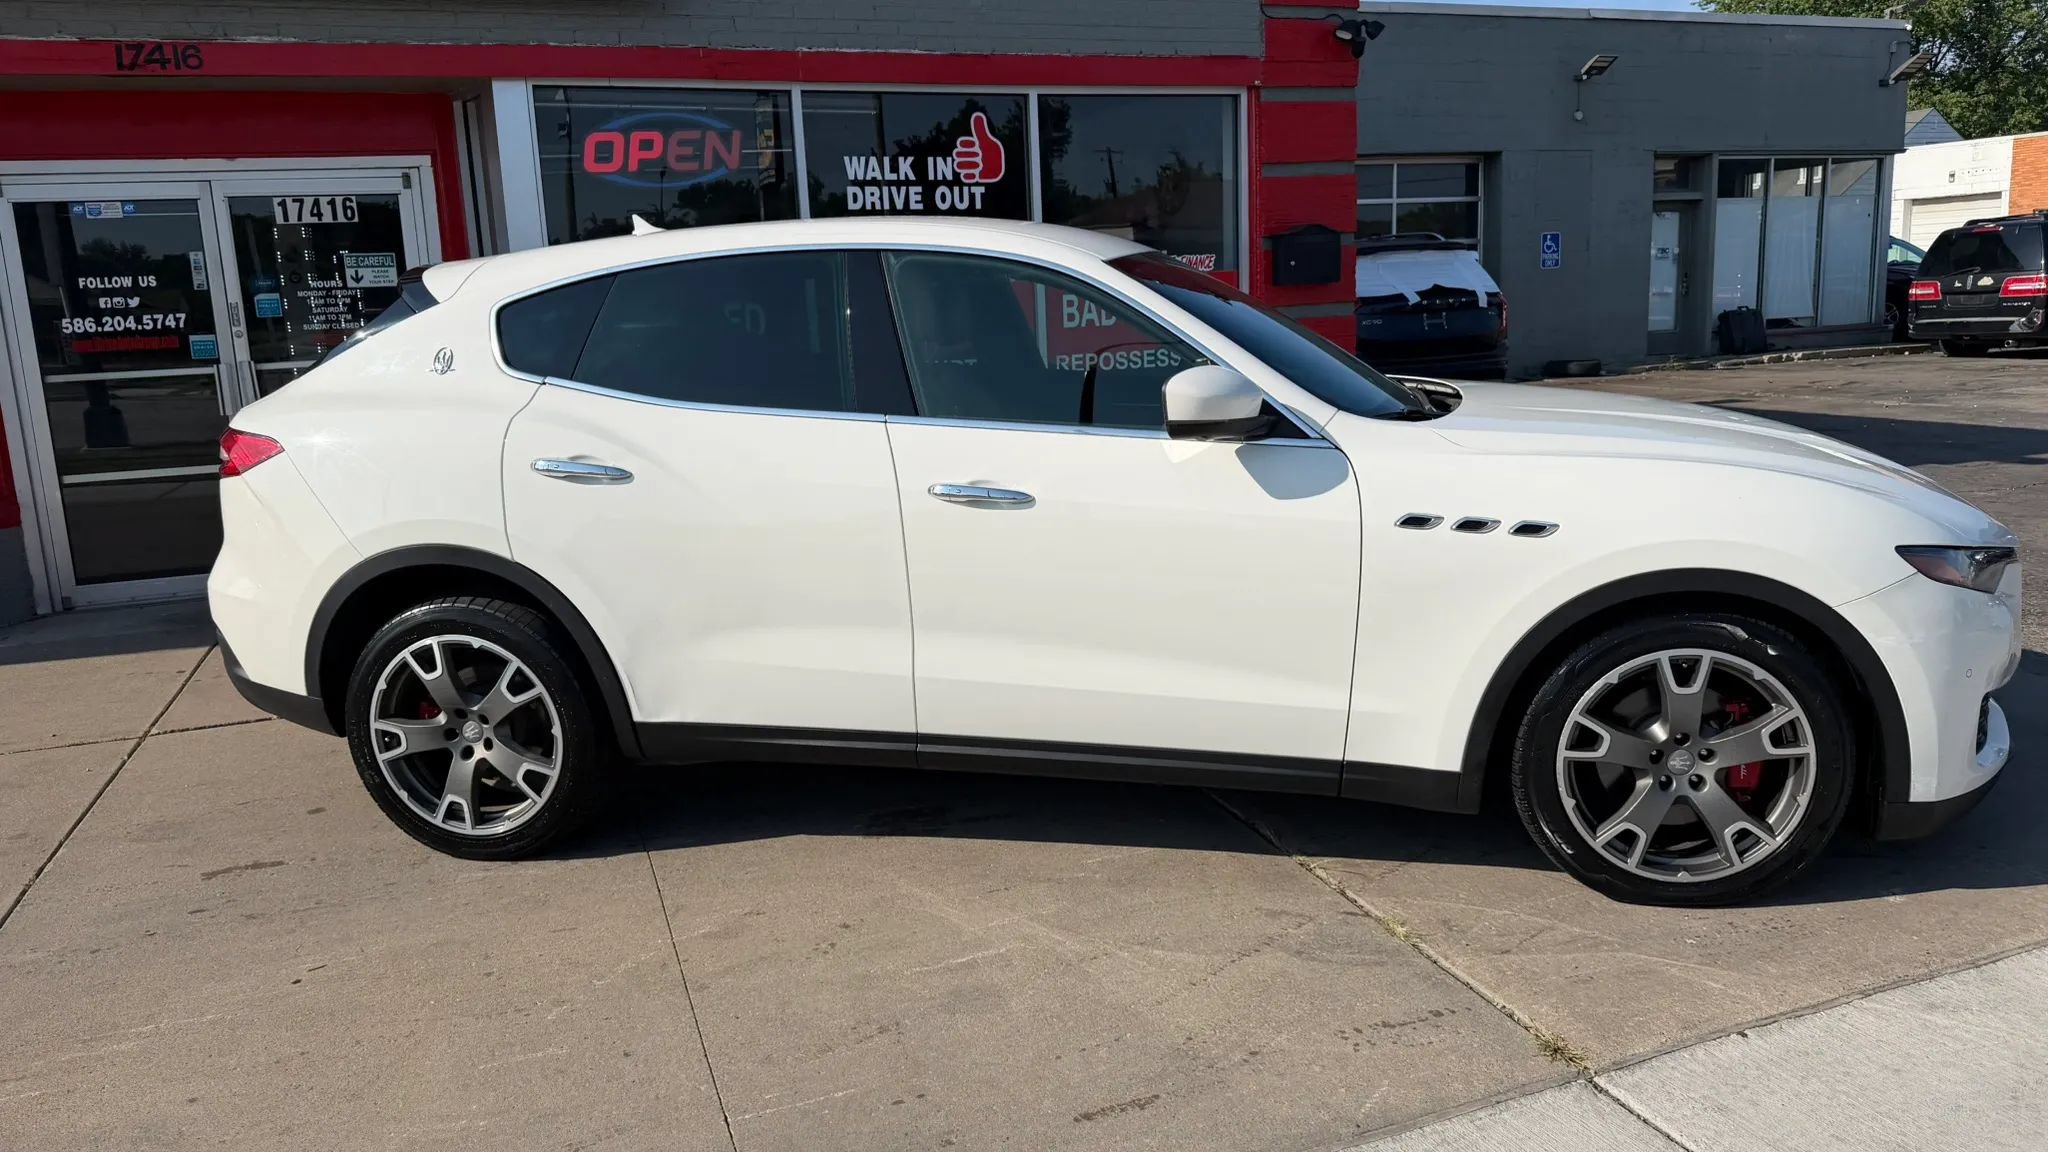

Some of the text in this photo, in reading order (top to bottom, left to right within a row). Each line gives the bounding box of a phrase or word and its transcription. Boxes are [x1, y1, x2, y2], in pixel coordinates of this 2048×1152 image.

[115, 43, 204, 71] 17416
[582, 129, 741, 173] OPEN
[844, 156, 953, 181] WALK IN
[847, 186, 986, 210] DRIVE OUT
[276, 197, 356, 223] 17416
[346, 256, 394, 267] BE CAREFUL
[78, 275, 157, 289] FOLLOW US
[310, 280, 343, 288] HOURS
[297, 290, 326, 298] MONDAY
[332, 289, 357, 297] FRIDAY
[325, 297, 337, 305] TO
[312, 306, 348, 314] SATURDAY
[61, 313, 187, 333] 586.204.5747
[303, 322, 360, 331] SUNDAY CLOSED
